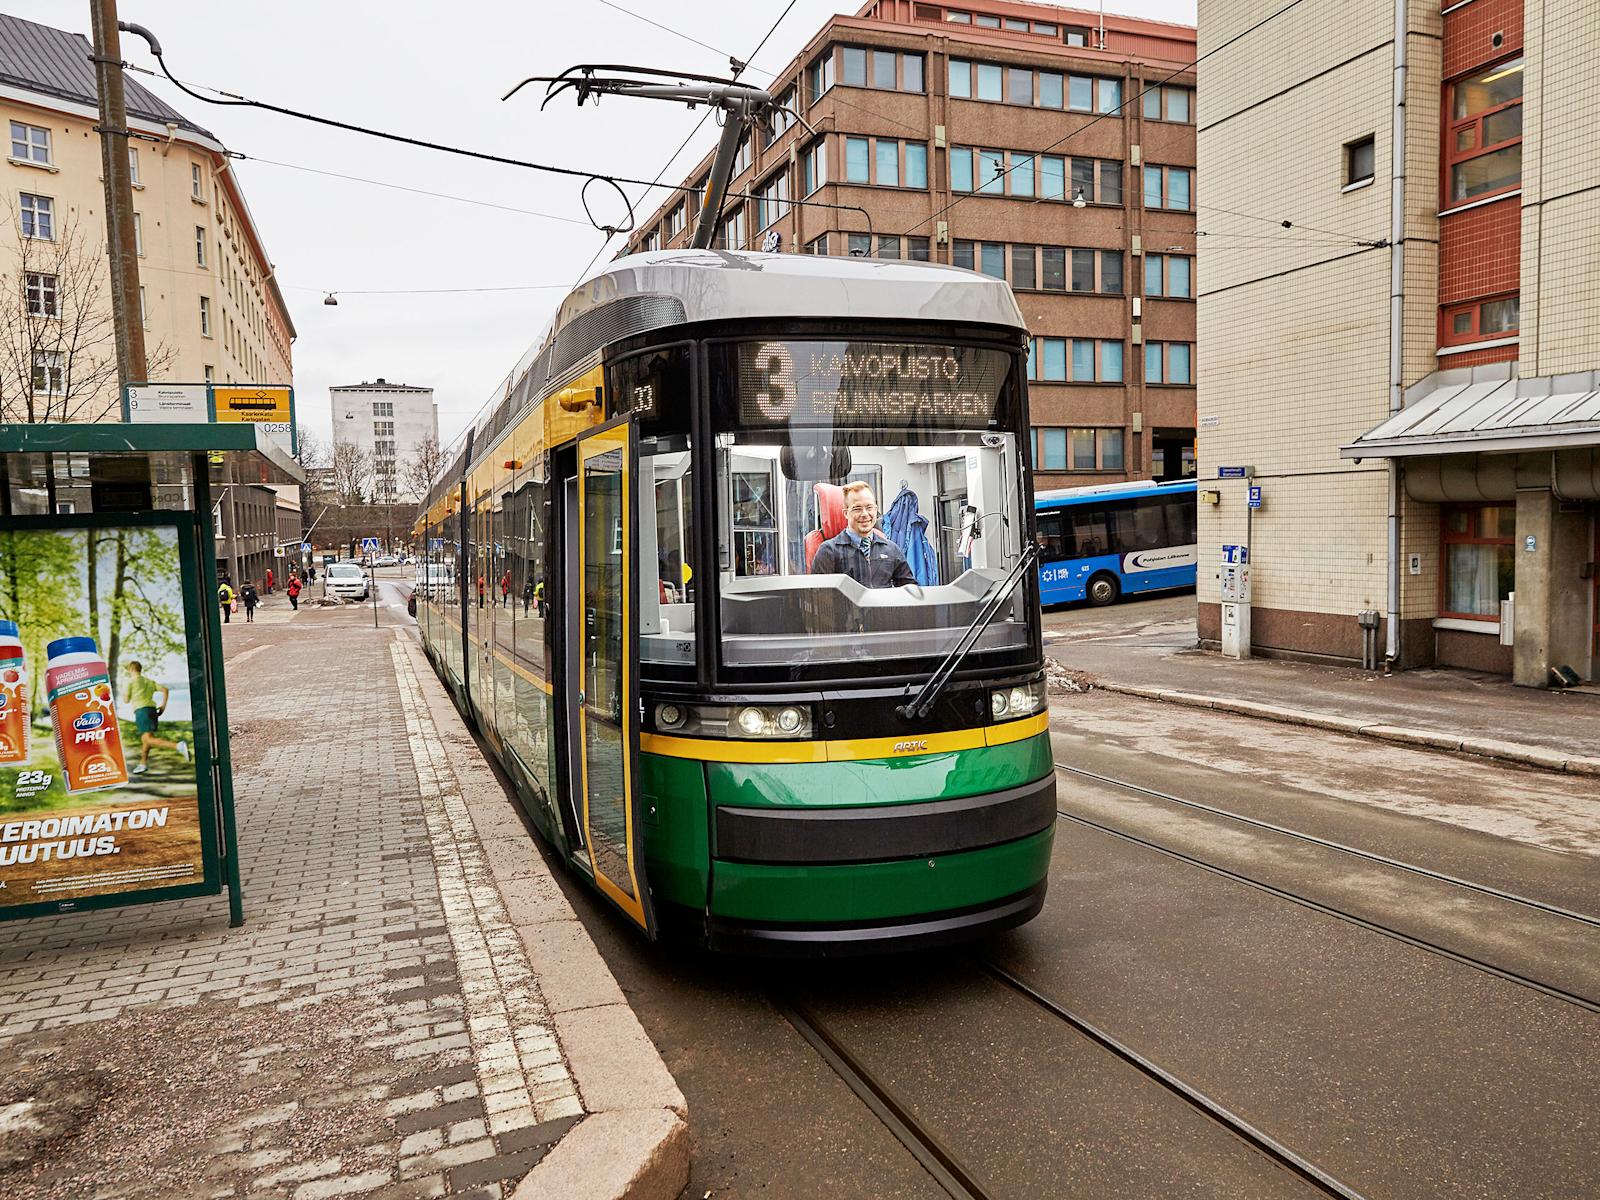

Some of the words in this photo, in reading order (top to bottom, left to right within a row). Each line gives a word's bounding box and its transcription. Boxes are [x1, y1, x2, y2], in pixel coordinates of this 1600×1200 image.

[810, 353, 959, 379] KAIVOPUISTO
[755, 342, 798, 420] 3
[130, 389, 138, 399] 3
[131, 400, 139, 410] 9
[812, 391, 989, 416] BRUNNSPARKEN
[75, 717, 101, 729] Valio
[75, 732, 106, 744] PRO
[893, 740, 929, 753] ARTIC
[16, 770, 53, 786] 23g
